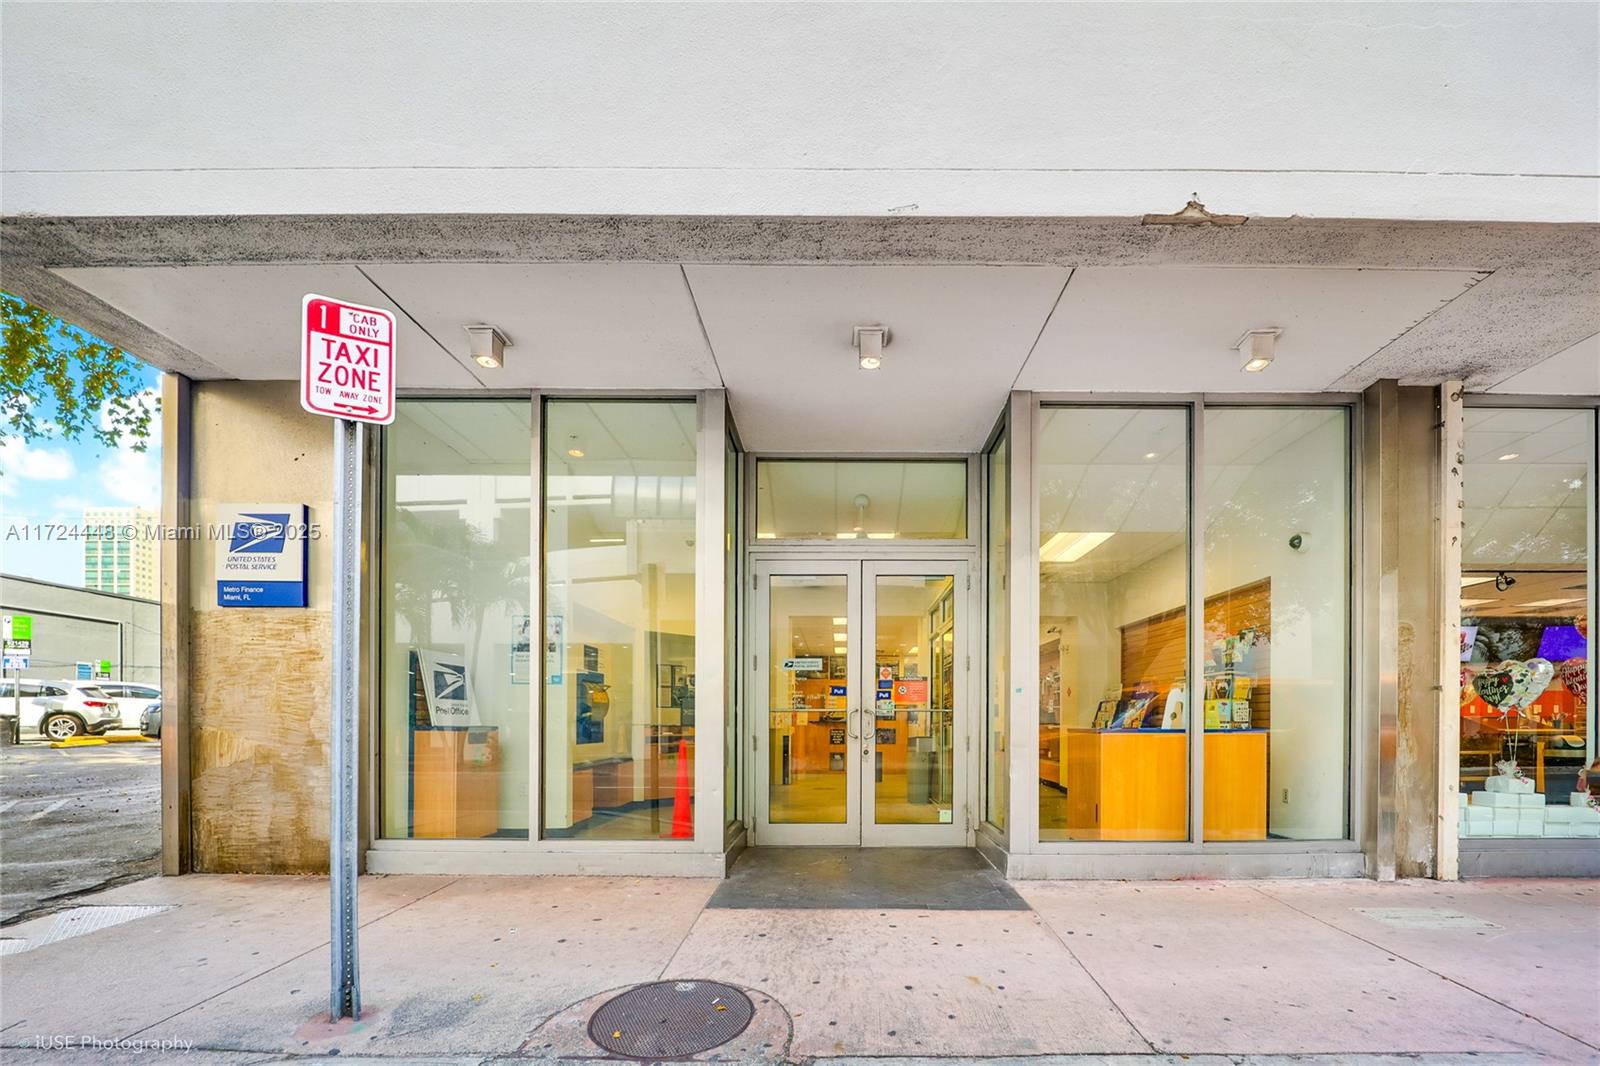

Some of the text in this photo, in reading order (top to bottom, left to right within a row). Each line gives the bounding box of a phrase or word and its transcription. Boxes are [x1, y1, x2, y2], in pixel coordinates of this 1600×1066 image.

[319, 304, 327, 329] 1
[352, 313, 377, 326] CAB
[349, 324, 379, 338] ONLY
[321, 337, 378, 368] TAXI
[318, 361, 381, 392] ZONE
[315, 385, 383, 404] TOW AWAY ZONE
